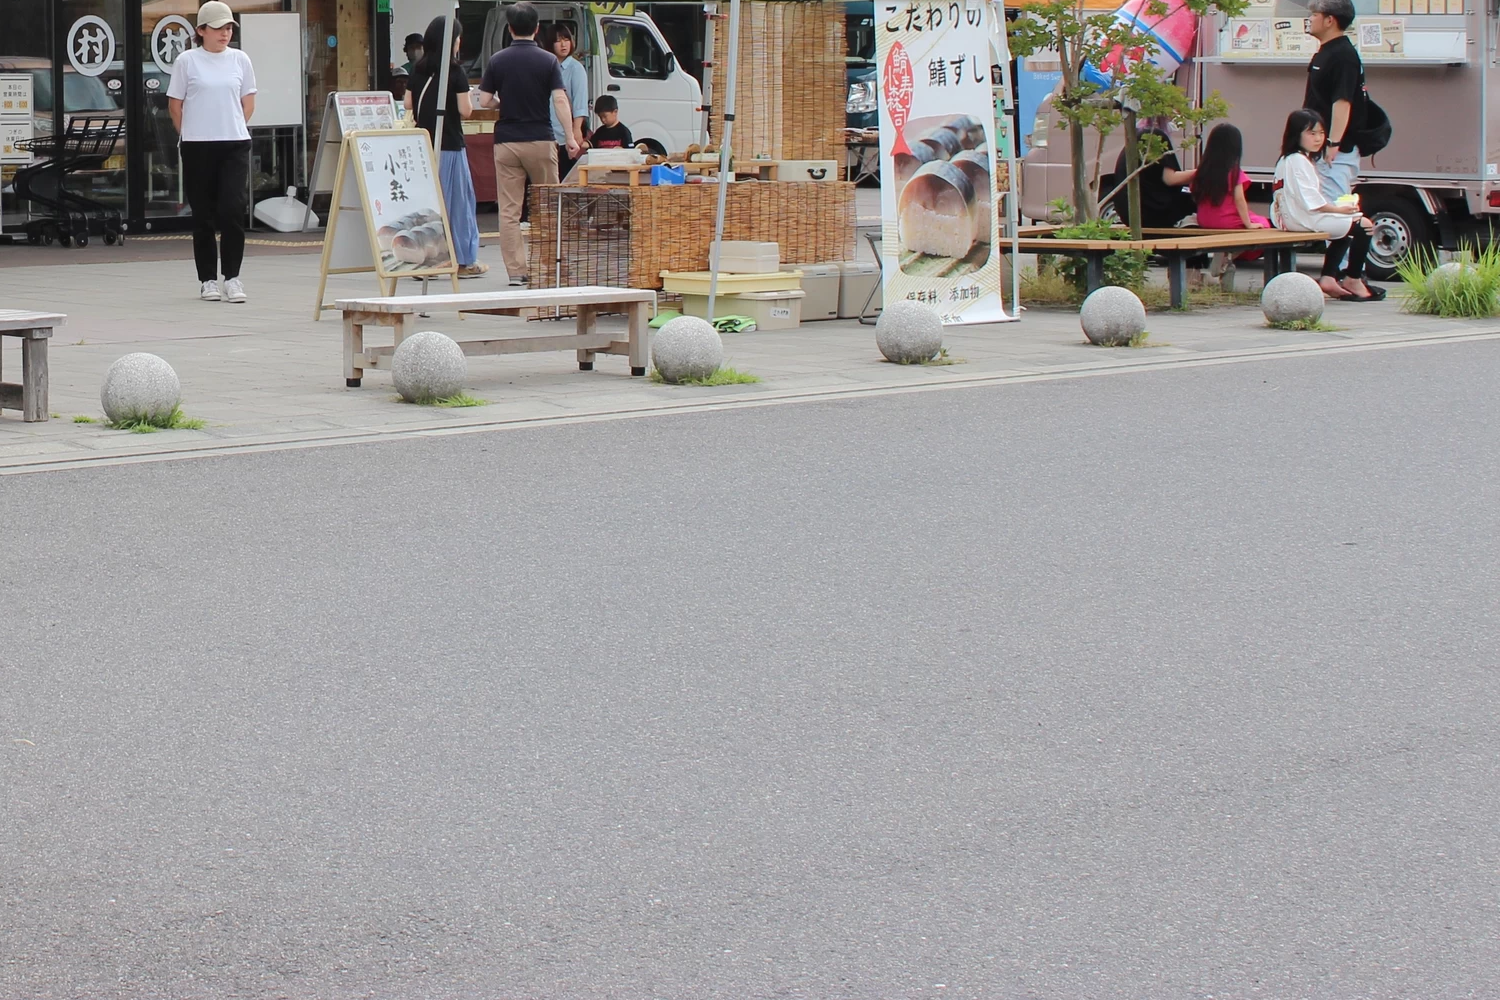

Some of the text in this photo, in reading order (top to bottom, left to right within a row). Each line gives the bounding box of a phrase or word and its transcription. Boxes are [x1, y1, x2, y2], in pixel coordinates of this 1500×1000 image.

[885, 2, 982, 33] こだわりの
[75, 28, 107, 64] 村
[159, 27, 190, 63] 村
[883, 64, 901, 110] 小森
[892, 46, 914, 128] 鯖寿司
[928, 53, 985, 88] 鯖ずし
